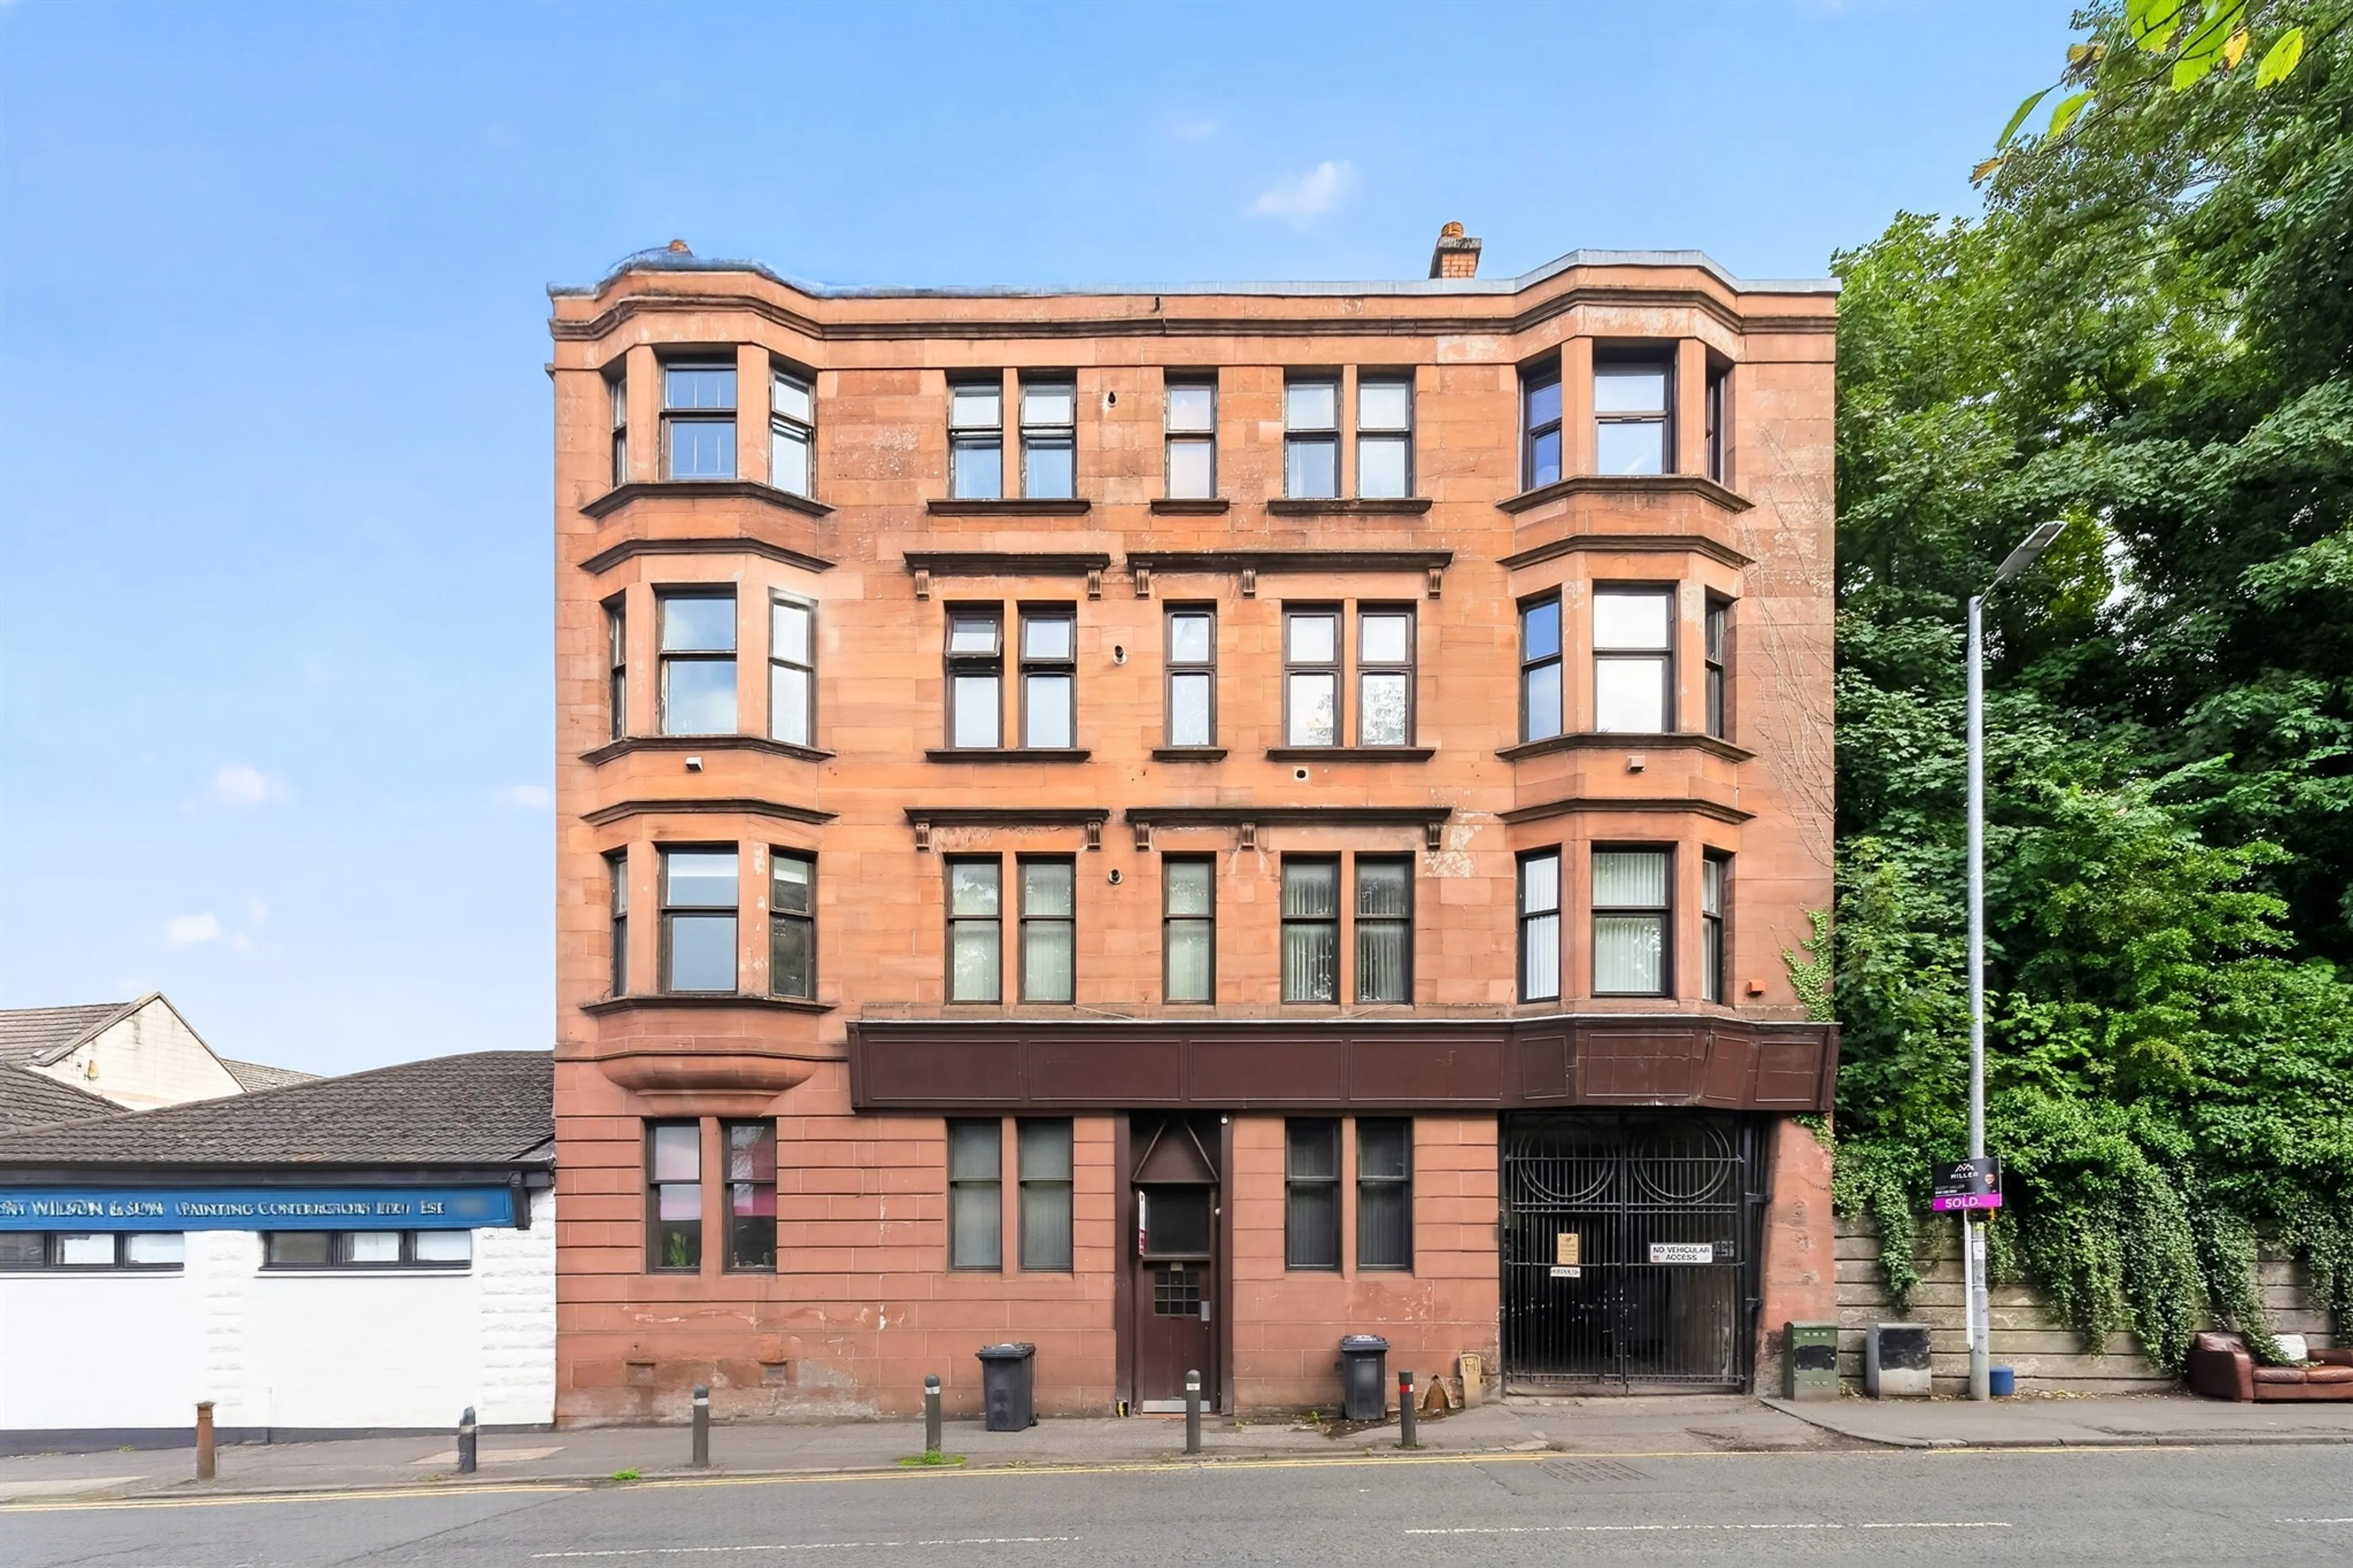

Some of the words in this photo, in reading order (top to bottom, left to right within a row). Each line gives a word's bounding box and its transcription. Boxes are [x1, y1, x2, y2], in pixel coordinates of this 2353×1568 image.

[31, 1200, 104, 1216] WILSON
[177, 1202, 254, 1216] PAINTING
[1945, 1197, 1978, 1208] SOLD
